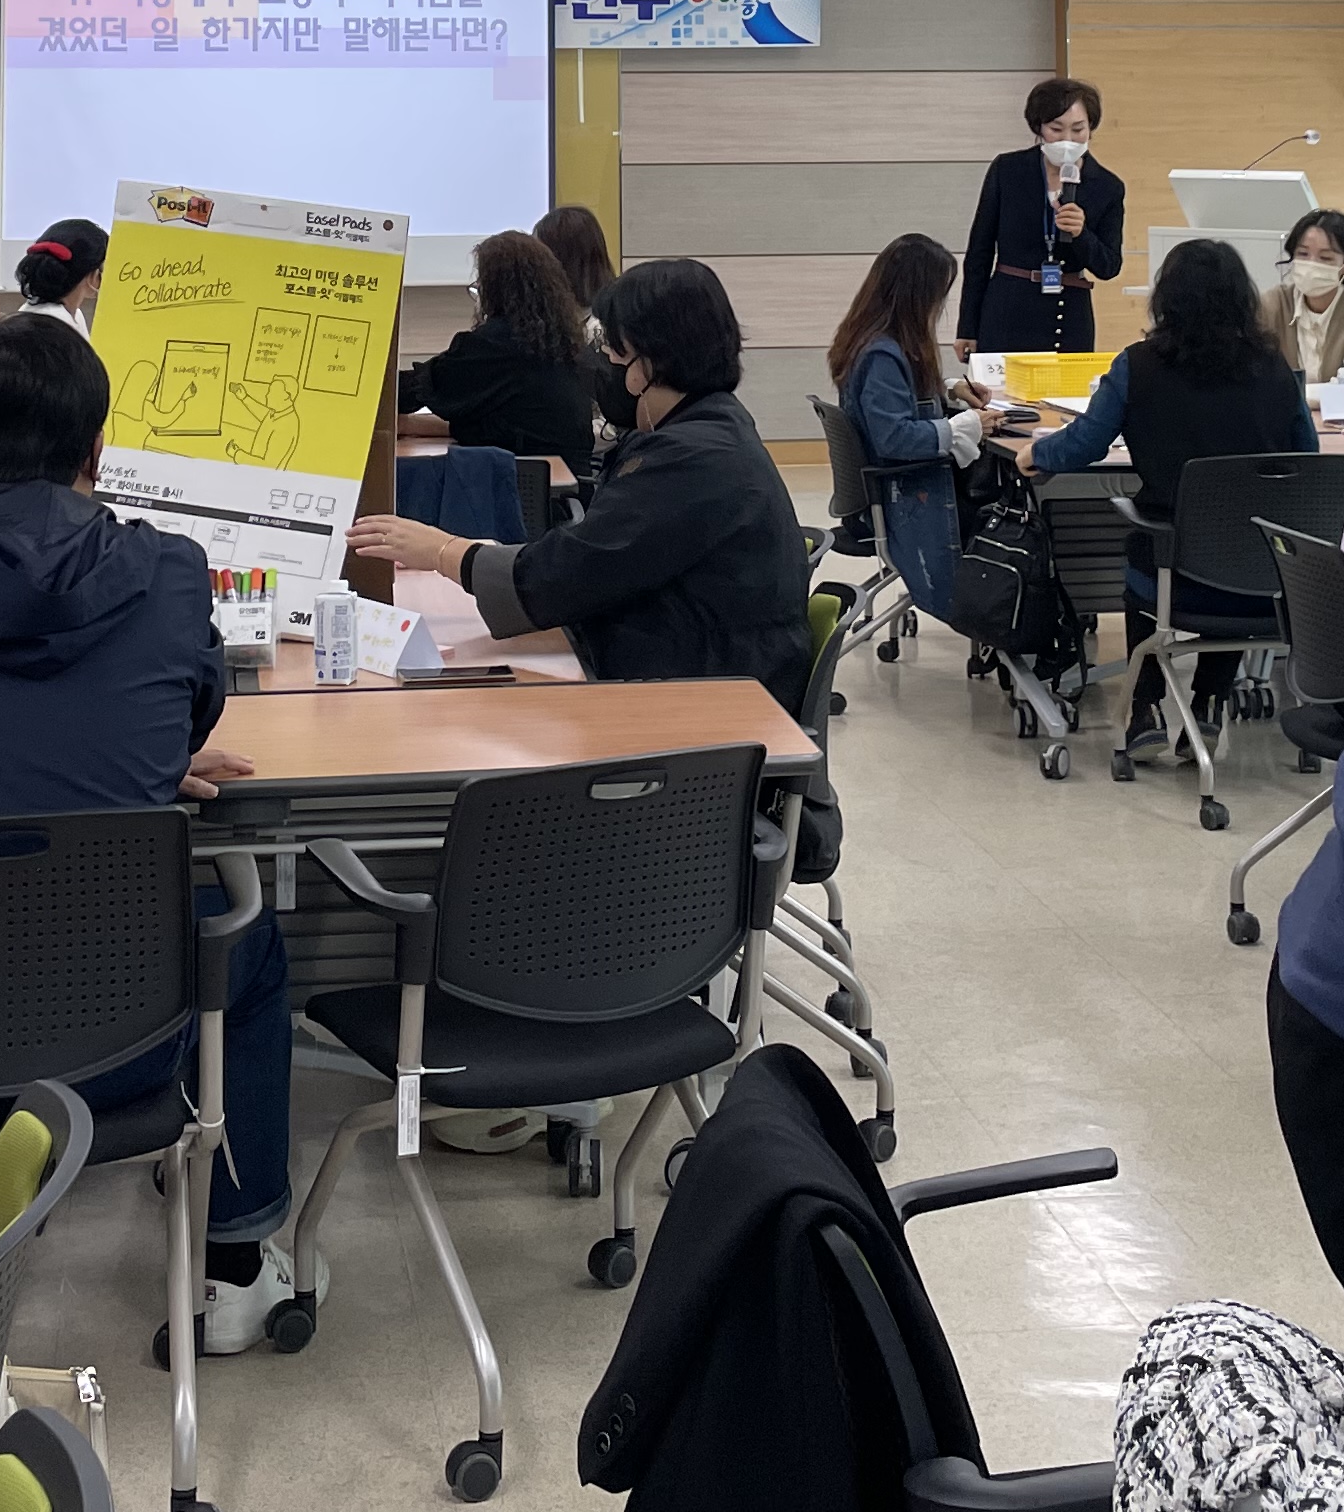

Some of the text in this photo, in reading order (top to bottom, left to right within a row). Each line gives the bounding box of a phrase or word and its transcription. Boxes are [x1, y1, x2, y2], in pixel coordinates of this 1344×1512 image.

[151, 17, 179, 52] 일
[202, 17, 322, 52] 한가지만
[344, 17, 508, 52] 말해본다면?
[157, 196, 207, 214] Post-it
[306, 212, 372, 231] Easel Pads
[119, 254, 206, 282] Go ahead,
[275, 264, 378, 292] 최고의 미팅 솔루션
[133, 278, 233, 305] Collaborate
[288, 611, 312, 625] 3M
